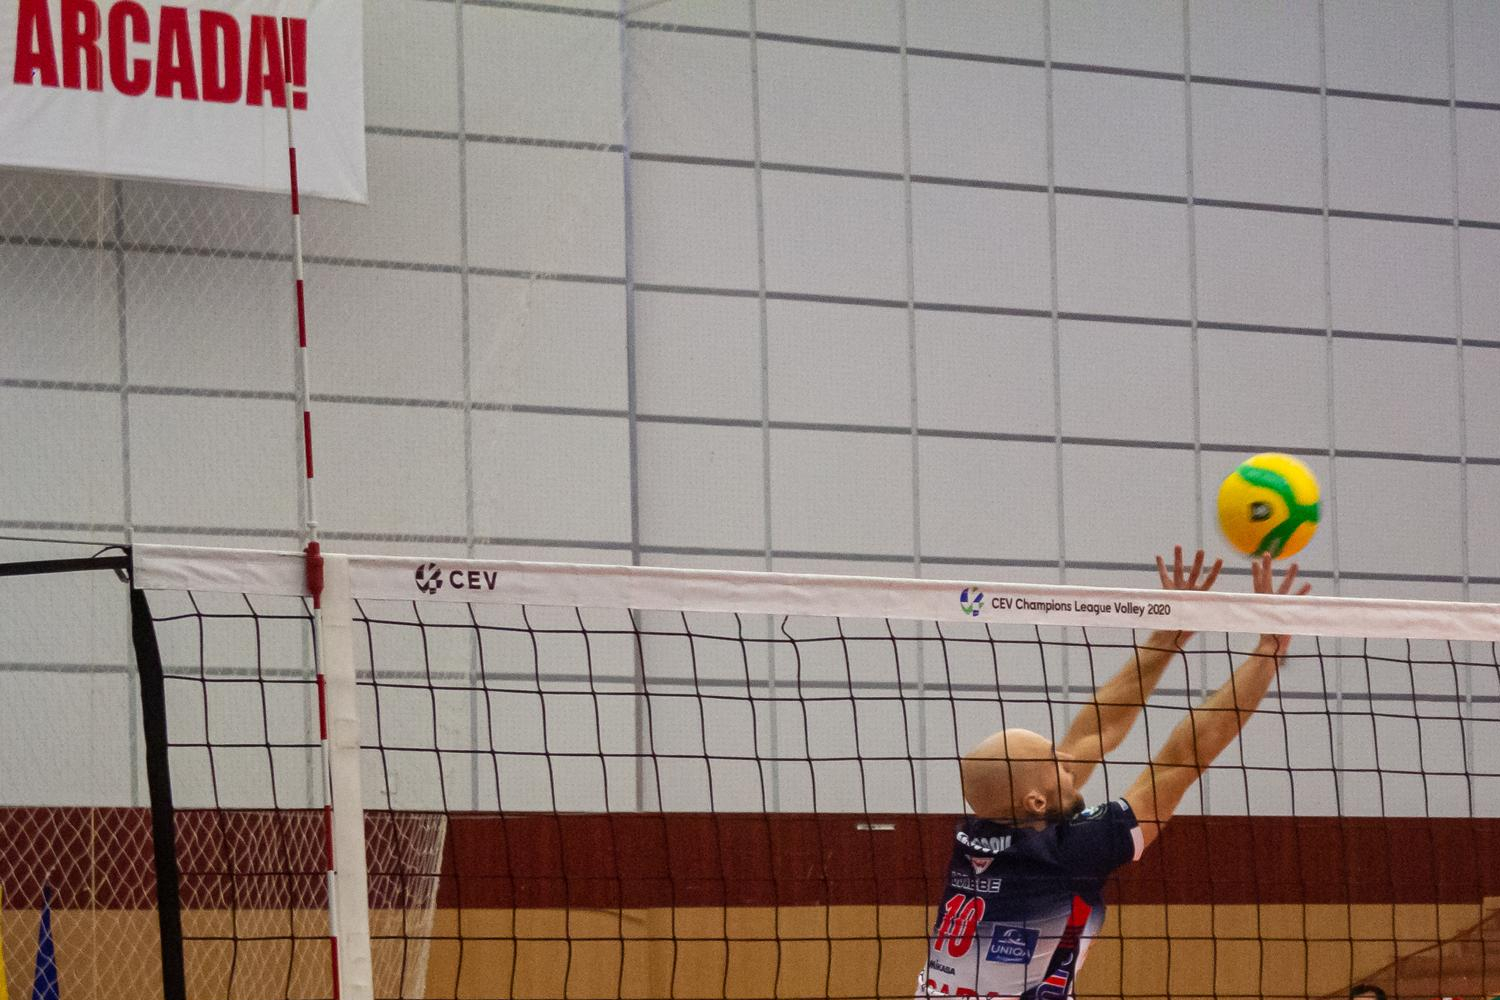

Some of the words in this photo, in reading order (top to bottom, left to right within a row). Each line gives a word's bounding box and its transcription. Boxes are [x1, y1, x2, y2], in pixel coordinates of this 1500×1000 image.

[13, 0, 308, 110] ARCADA!
[448, 569, 498, 591] CEV
[991, 597, 1013, 609] CEV
[1015, 598, 1072, 615] Champions
[1074, 600, 1111, 616] League
[1114, 602, 1145, 617] Volley
[1148, 604, 1171, 615] 2020
[935, 894, 985, 958] 10
